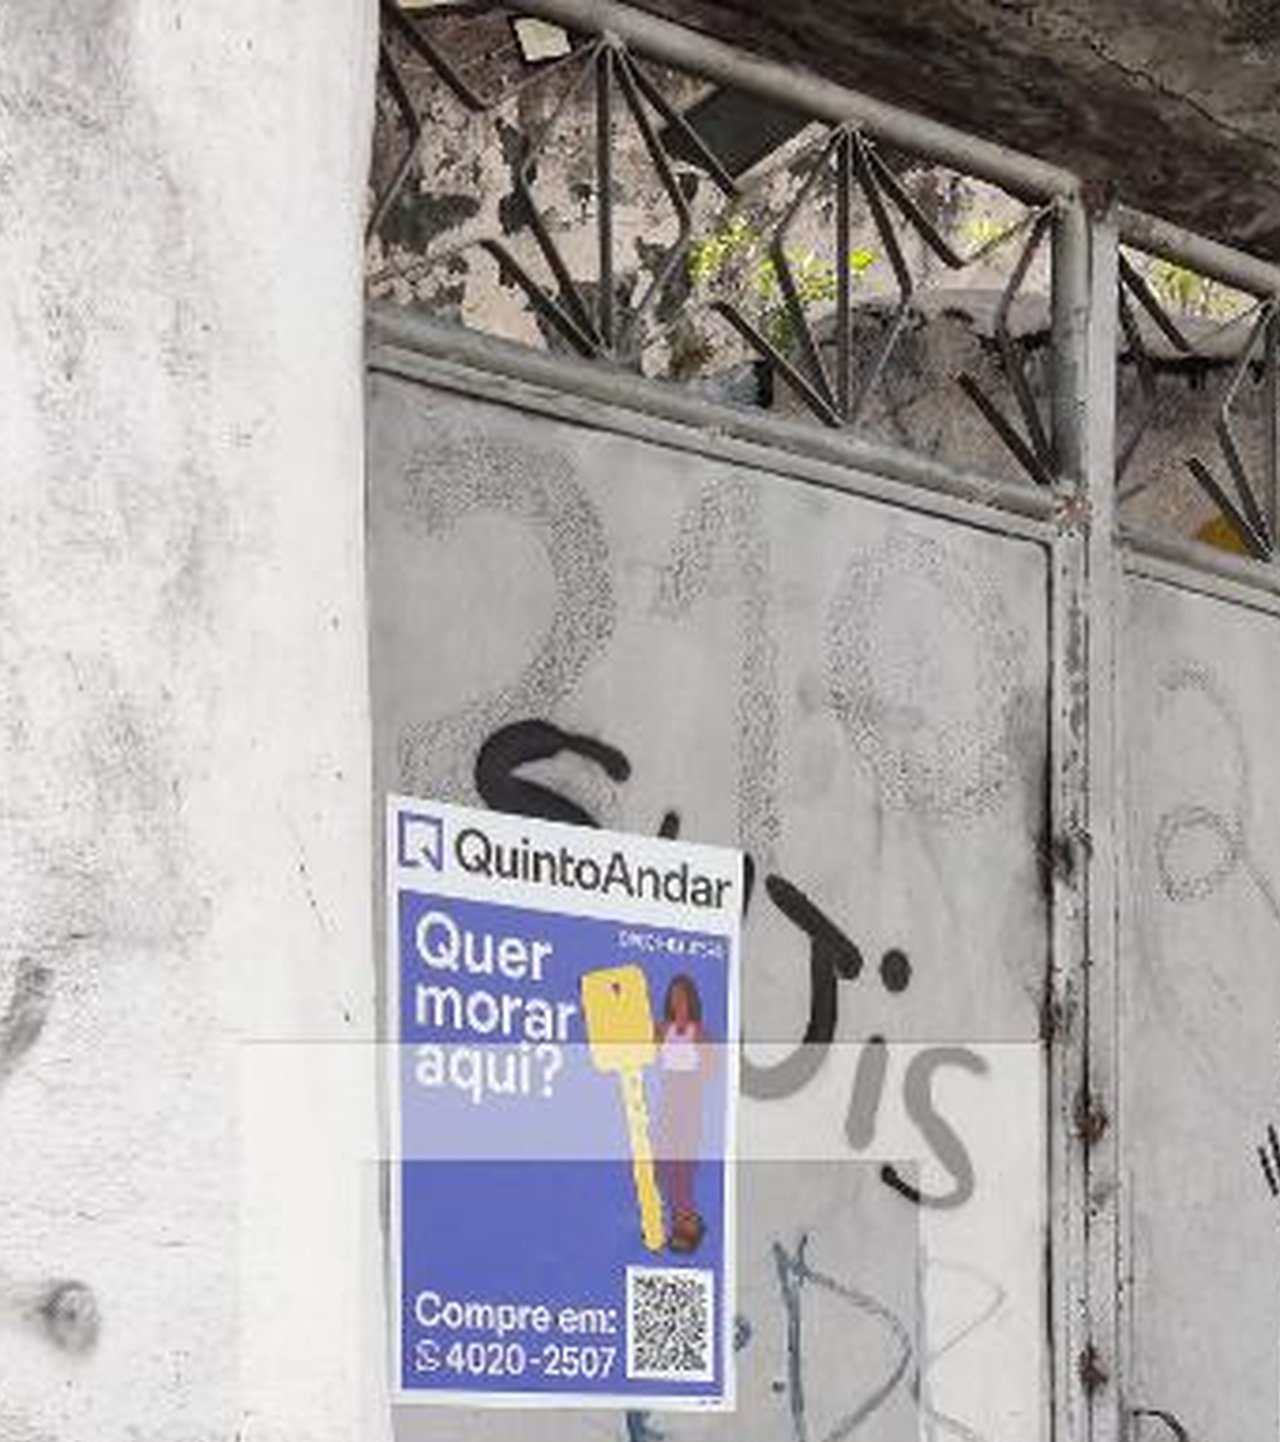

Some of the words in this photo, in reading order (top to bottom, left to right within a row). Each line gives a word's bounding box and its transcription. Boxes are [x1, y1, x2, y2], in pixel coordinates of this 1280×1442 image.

[453, 828, 732, 909] QuintoAndar
[414, 911, 553, 981] Quer
[414, 983, 578, 1042] morar
[414, 1040, 563, 1104] aqui?
[414, 1291, 551, 1336] Compre
[557, 1307, 618, 1336] em:
[446, 1343, 617, 1378] 4020-2507
